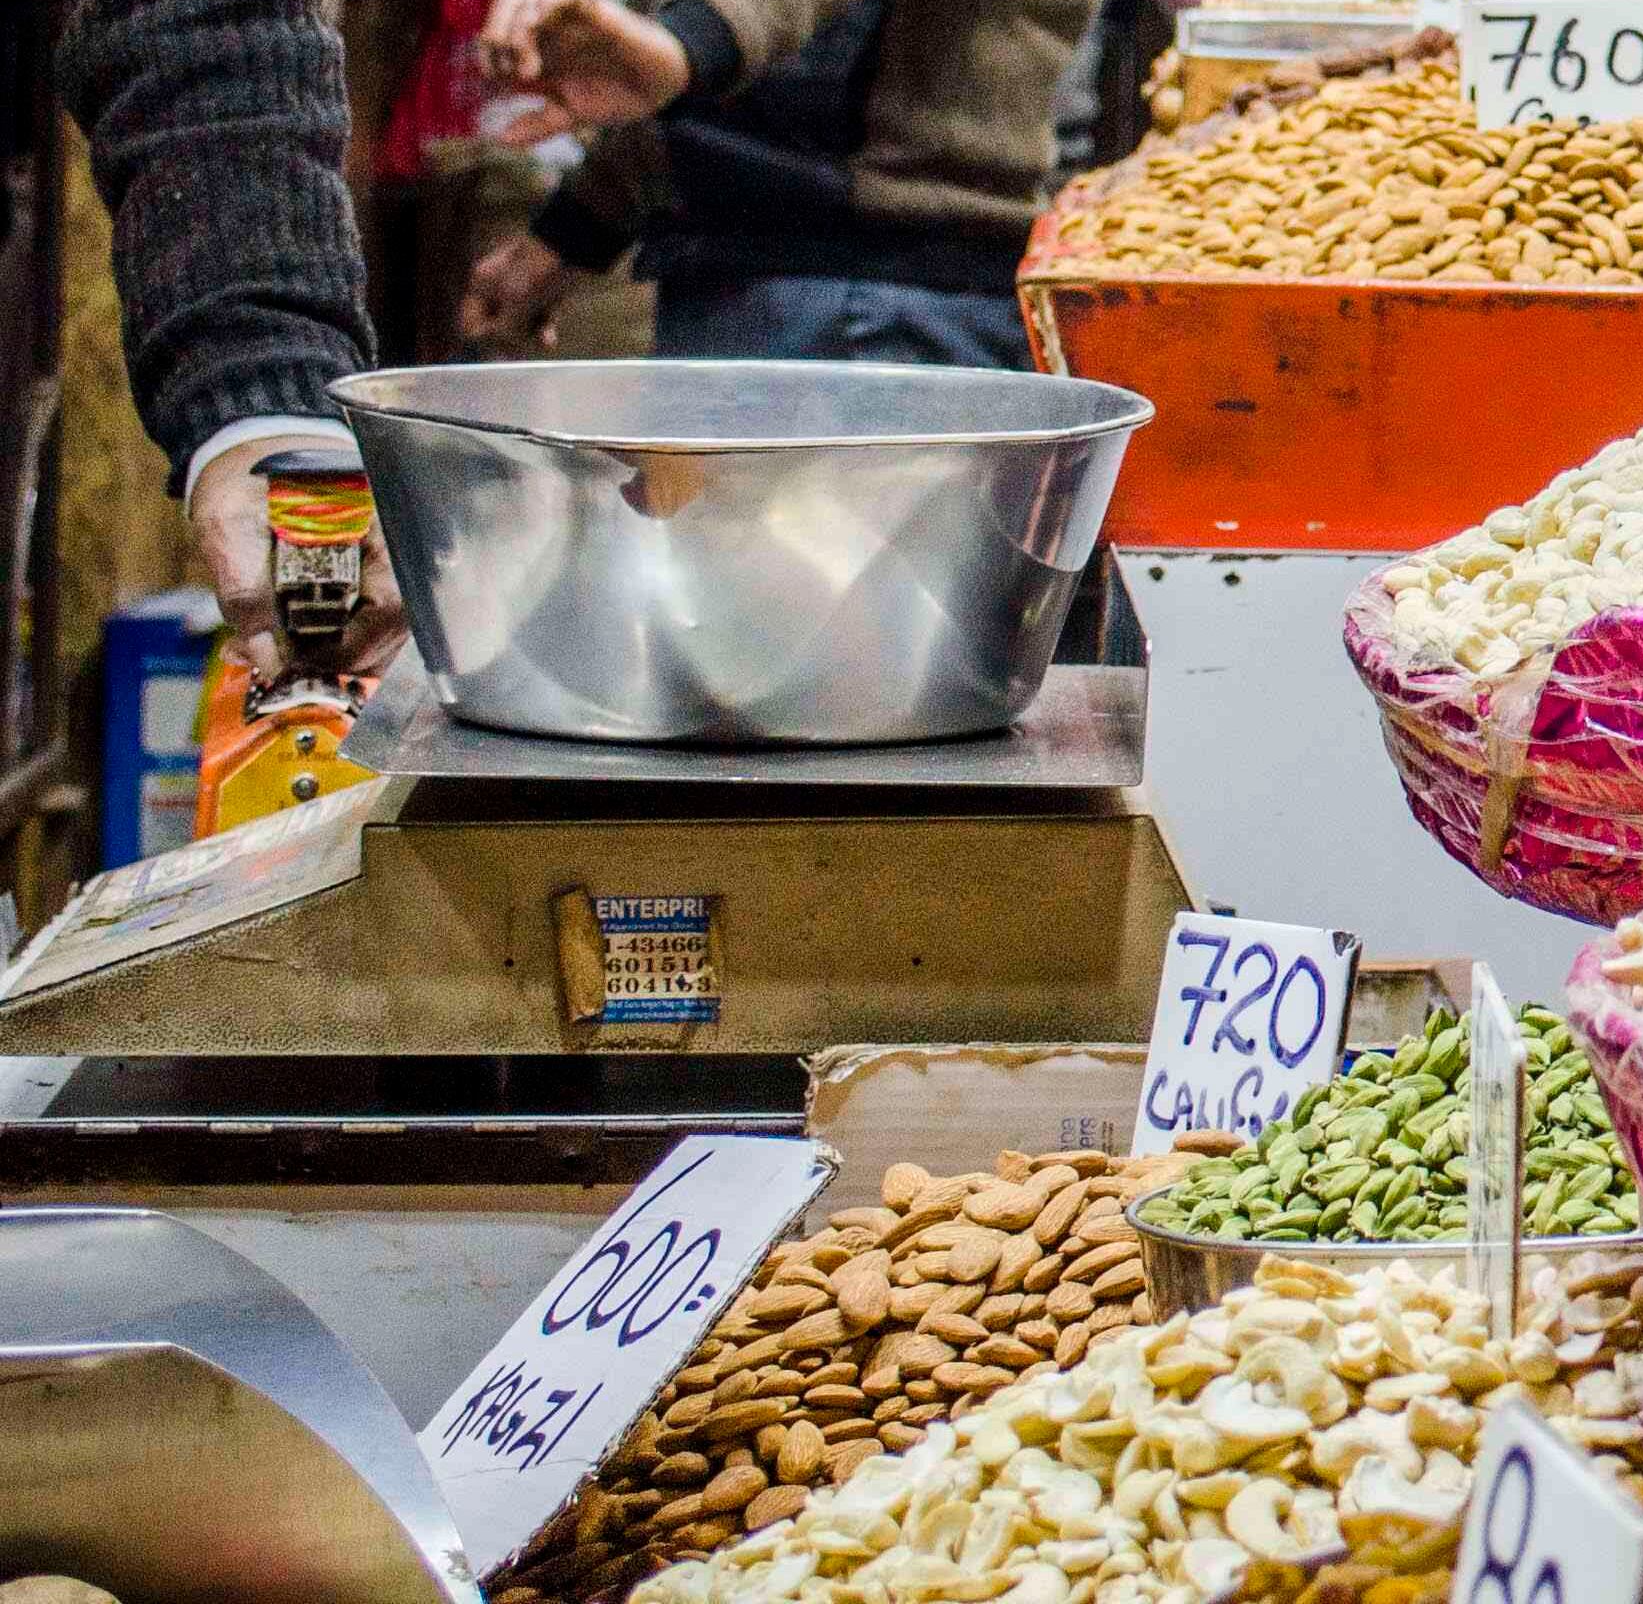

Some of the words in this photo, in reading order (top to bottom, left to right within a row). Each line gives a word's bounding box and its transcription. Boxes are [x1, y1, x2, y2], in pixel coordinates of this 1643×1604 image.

[596, 897, 709, 920] ENTERPRI
[1176, 928, 1327, 1070] 720
[440, 1358, 605, 1475] KAGZI
